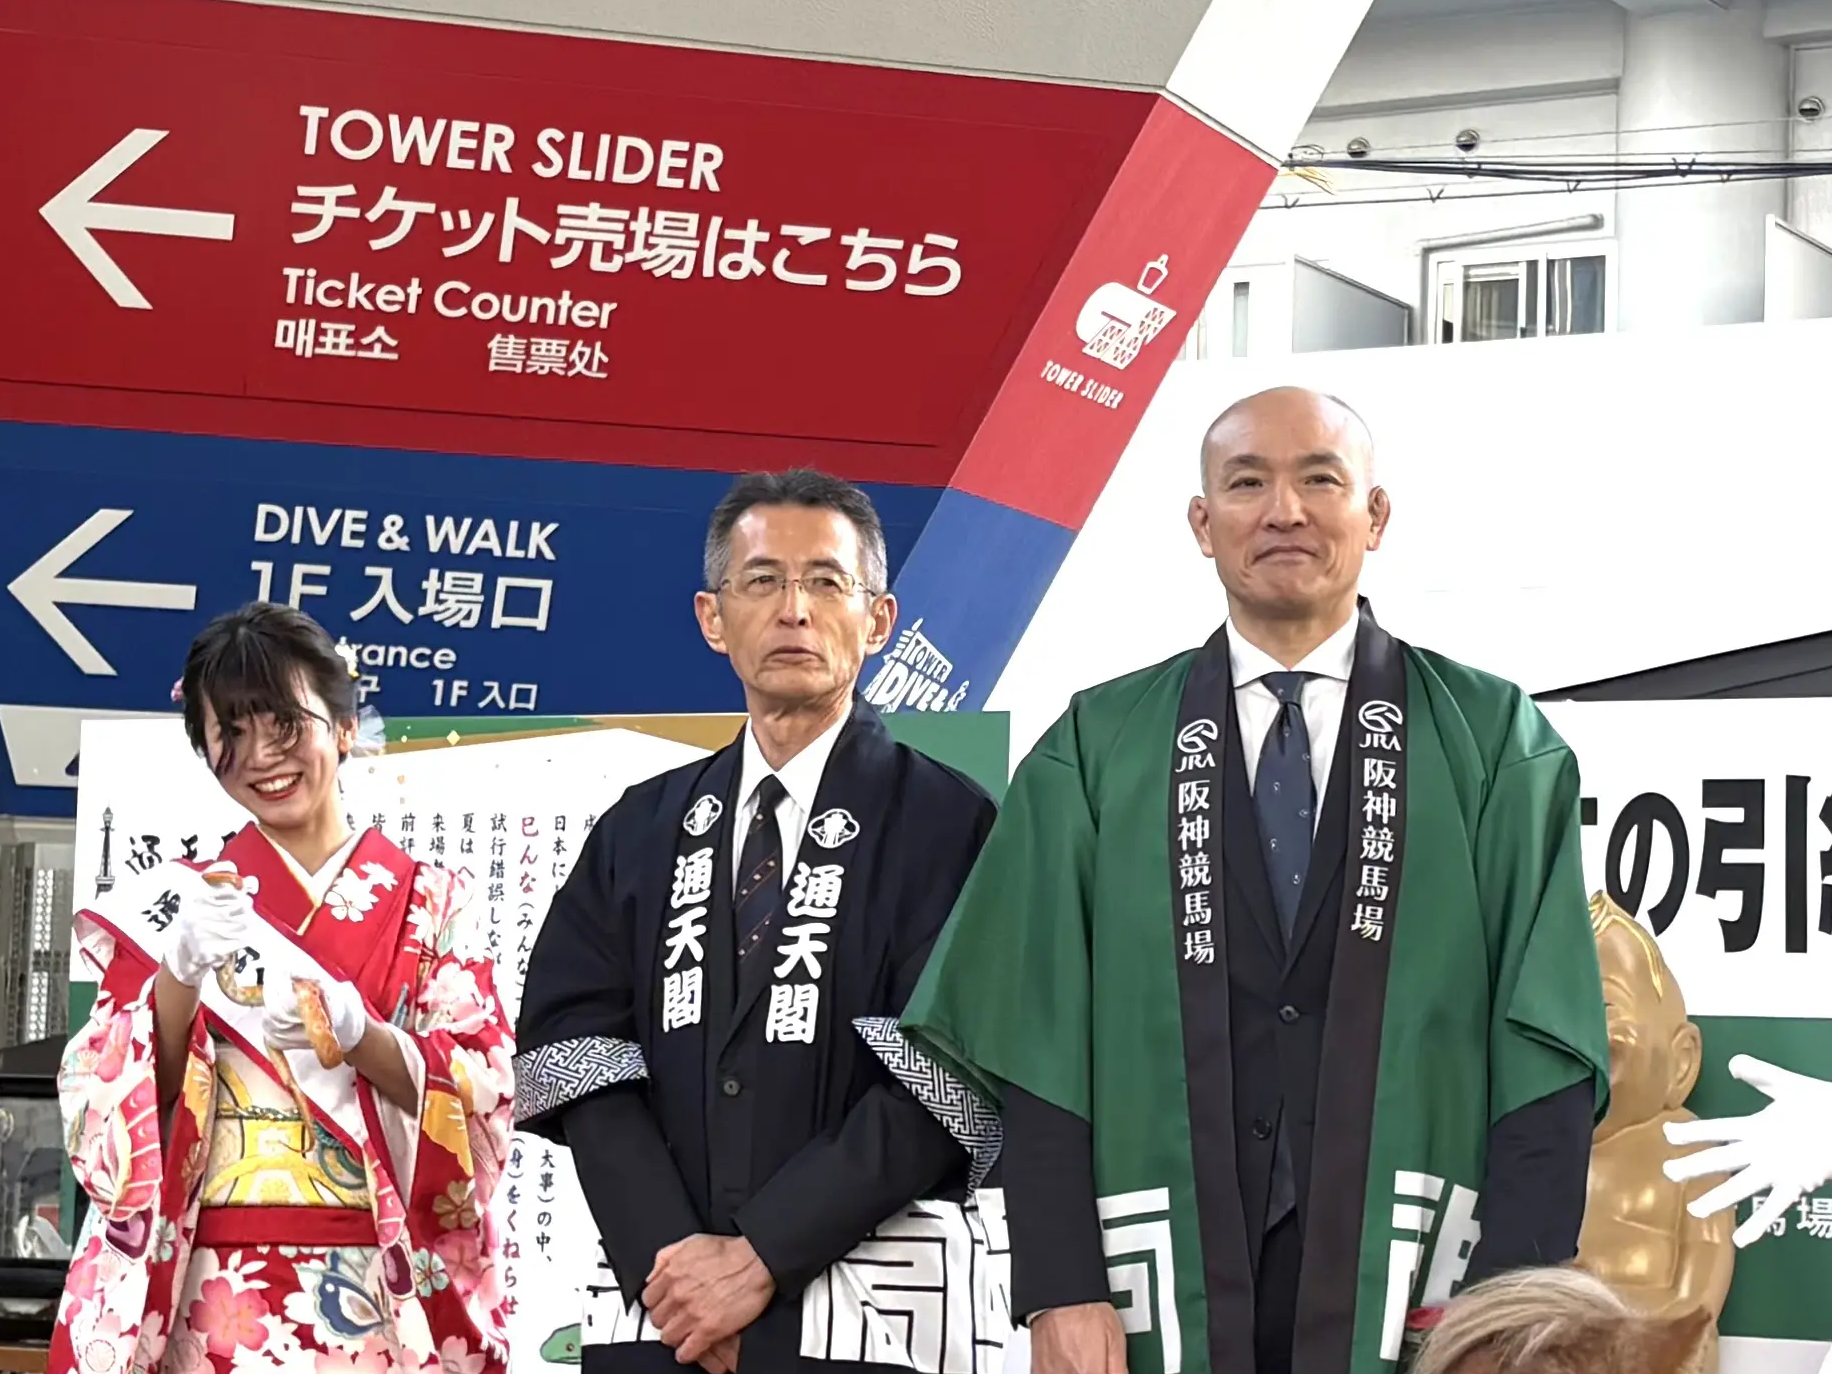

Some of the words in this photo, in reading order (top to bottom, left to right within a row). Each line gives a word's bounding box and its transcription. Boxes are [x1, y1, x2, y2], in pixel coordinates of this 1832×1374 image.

[300, 105, 517, 174] TOWER
[532, 128, 725, 193] SLIDER
[289, 183, 963, 297] チケット売場はこちら
[282, 267, 423, 316] Ticket
[433, 280, 618, 331] Counter
[274, 318, 400, 362] 매표소
[486, 333, 610, 380] 售票处
[1040, 360, 1085, 393] TOWER
[1080, 378, 1125, 410] SLIDER
[254, 504, 368, 550] DIVE
[377, 516, 411, 553] &
[425, 515, 560, 562] WALK
[250, 560, 332, 614] 1F
[349, 567, 555, 632] 入場口
[351, 641, 458, 670] rance
[432, 679, 469, 707] 1F
[478, 680, 539, 712] 入口
[1175, 752, 1216, 773] JRA
[1359, 732, 1402, 752] JRA
[552, 814, 568, 891] 日本に
[1176, 779, 1216, 965] 阪神競馬場
[1351, 757, 1398, 942] 阪神競馬場
[487, 813, 508, 965] 試行錯誤しな
[662, 847, 714, 1033] 通天閣
[765, 861, 846, 1045] 通天閣
